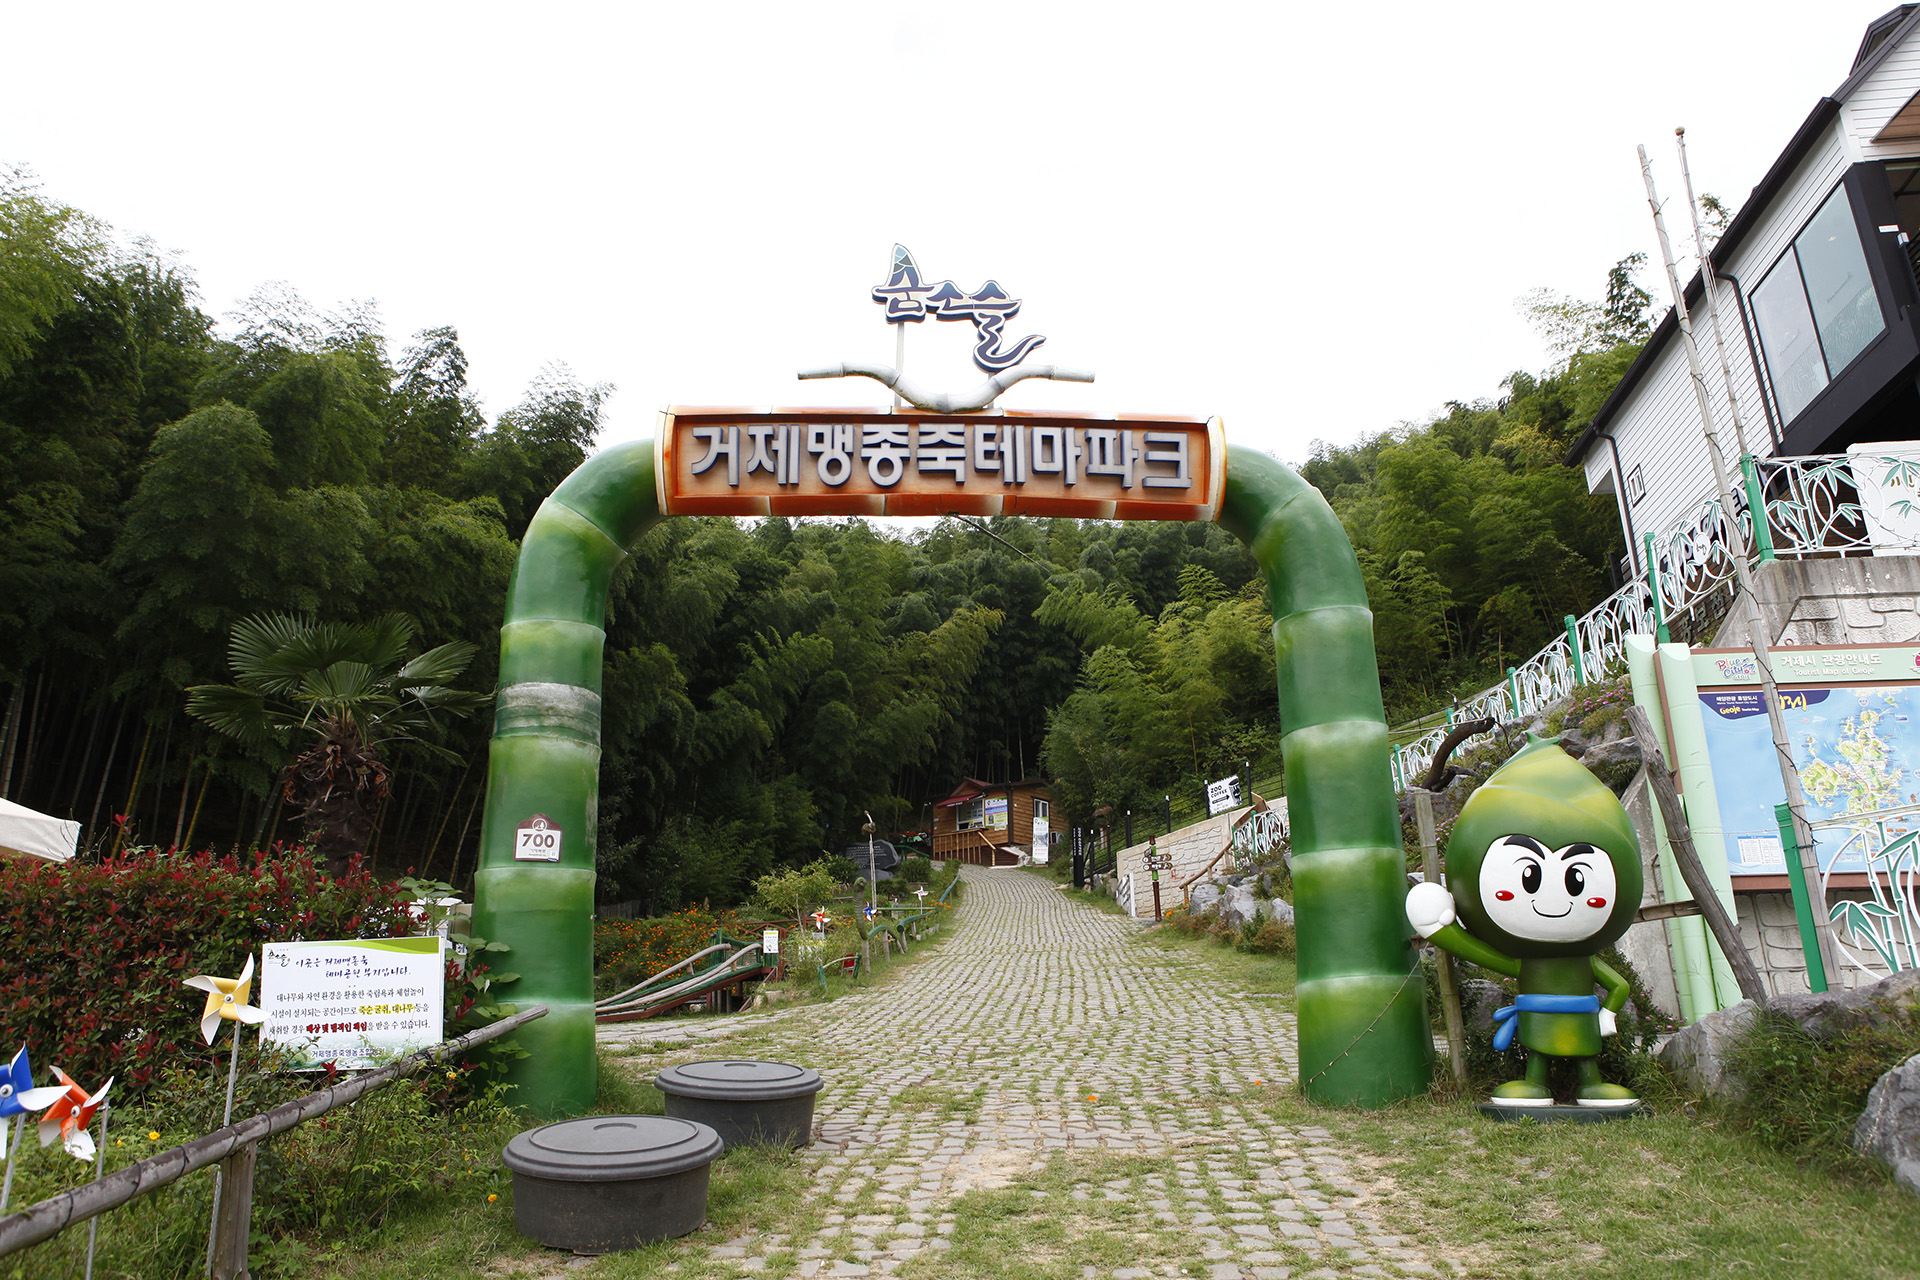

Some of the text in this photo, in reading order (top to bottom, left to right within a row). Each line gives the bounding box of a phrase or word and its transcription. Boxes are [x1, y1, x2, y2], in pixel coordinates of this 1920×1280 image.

[691, 423, 1192, 489] 거제맹종죽테마파크
[1715, 658, 1741, 670] Blue
[1781, 653, 1882, 667] 거제시 관광안내도
[1723, 666, 1743, 678] City
[1822, 668, 1838, 676] Map
[1852, 667, 1875, 675] Geoje
[1720, 705, 1741, 715] Geoje
[1210, 785, 1222, 793] ZOO
[1211, 789, 1228, 798] COFFEE
[522, 833, 555, 848] 700
[296, 955, 368, 968] 이곳은 거제맹종죽
[326, 966, 411, 979] 테마공원 부지입니다.
[276, 992, 304, 1002] 대나무와
[271, 1009, 292, 1019] 시설이
[293, 1007, 321, 1018] 설치되는
[323, 1006, 357, 1017] 공간이므로
[292, 1025, 305, 1034] 경우
[392, 1021, 399, 1030] 수
[400, 1019, 430, 1030] 있습니다.
